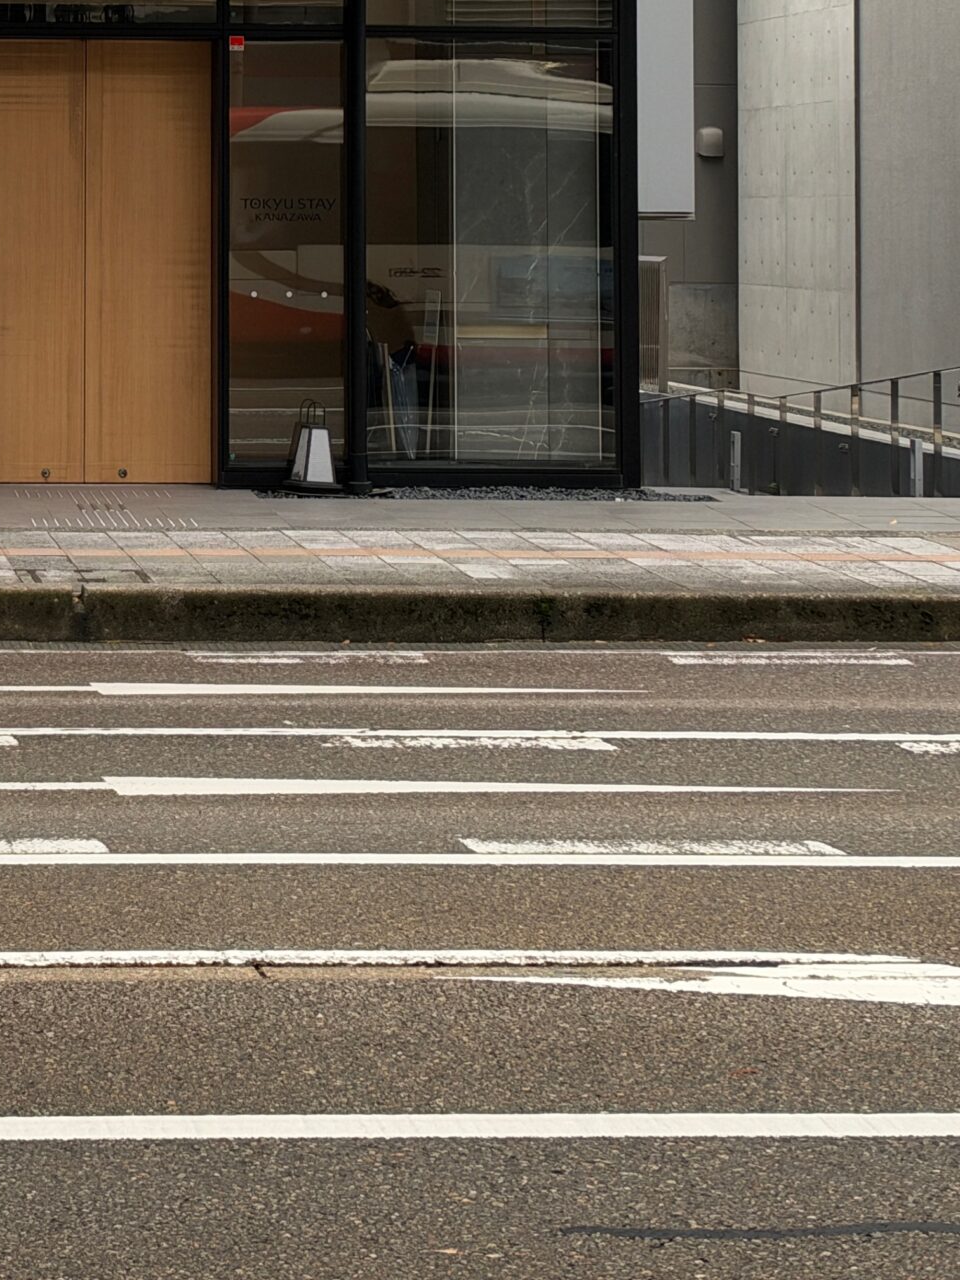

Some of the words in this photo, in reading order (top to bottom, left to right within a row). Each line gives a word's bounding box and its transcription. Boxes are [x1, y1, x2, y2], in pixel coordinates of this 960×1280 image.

[240, 198, 294, 211] TOKYU
[297, 198, 337, 211] STAY
[254, 212, 322, 222] KANAZAWA
